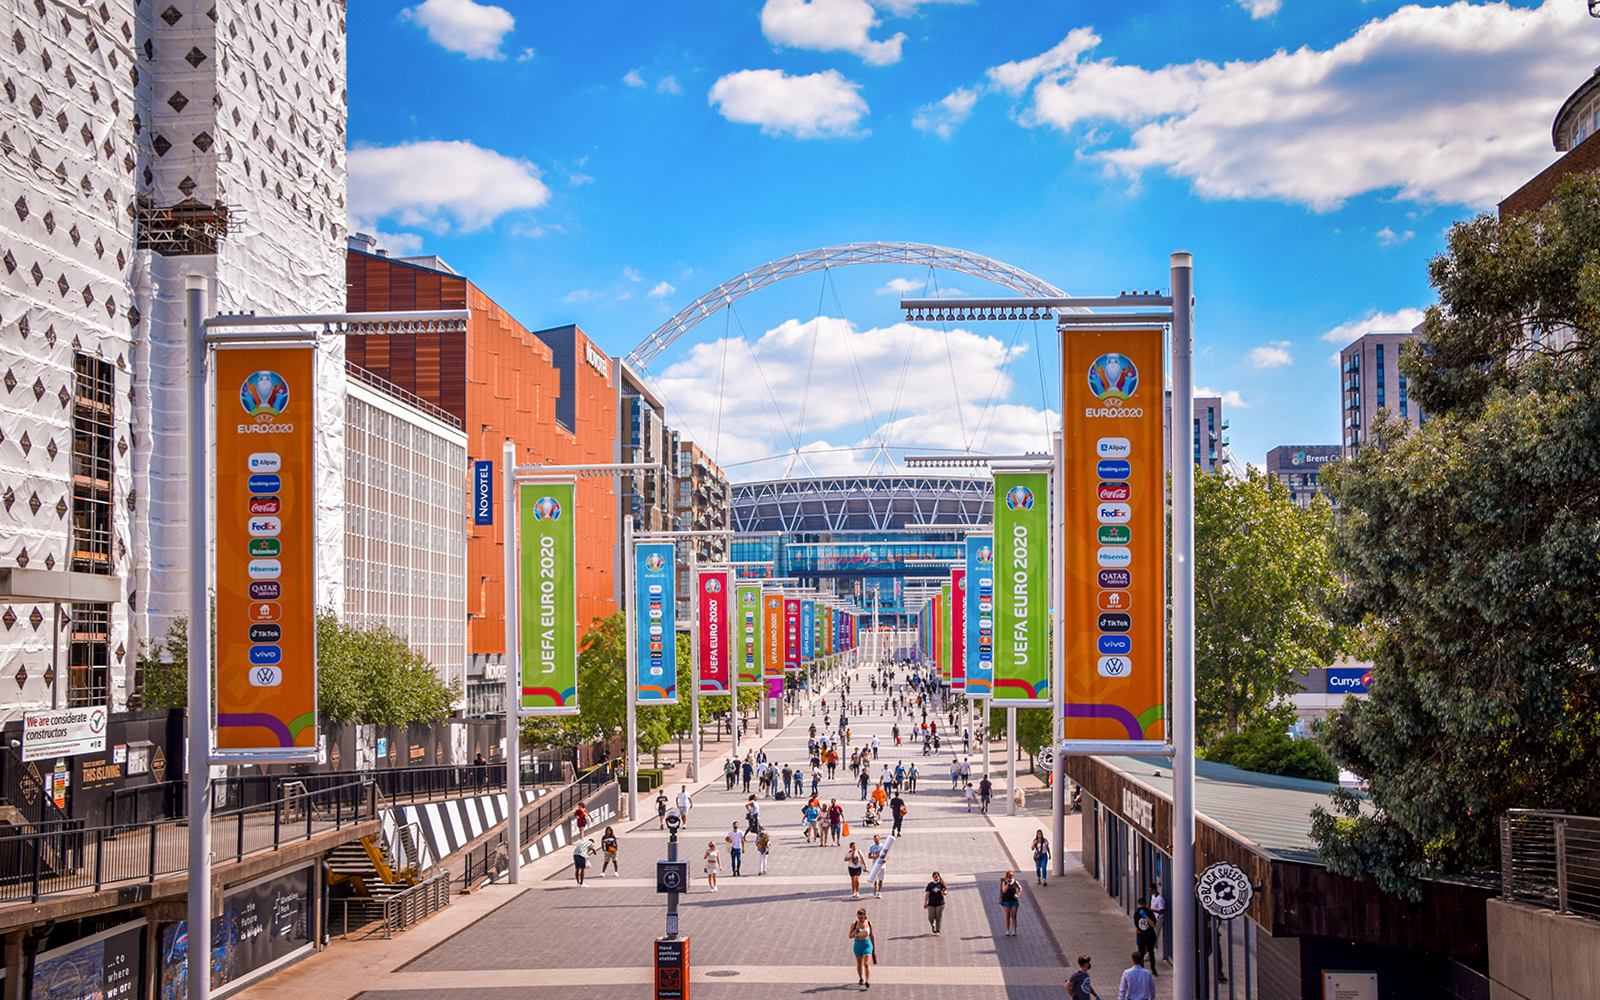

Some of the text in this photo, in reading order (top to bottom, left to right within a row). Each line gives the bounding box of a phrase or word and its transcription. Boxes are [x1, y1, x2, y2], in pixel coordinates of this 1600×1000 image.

[1103, 398, 1124, 407] UEFA
[254, 414, 275, 423] UEFA
[1085, 408, 1143, 418] EURO2020
[237, 423, 294, 434] EURO2020
[1306, 455, 1329, 463] Brent
[479, 464, 489, 517] NOVOTEL
[1101, 509, 1126, 517] FedEx
[252, 522, 277, 531] FedEx
[1101, 572, 1127, 581] QATAR
[252, 585, 278, 594] QATAR
[1013, 525, 1028, 665] UEFA EURO 2020
[540, 536, 555, 673] UEFA EURO 2020
[709, 599, 718, 673] UEFA EURO 2020
[1103, 640, 1125, 648] vivo
[485, 663, 507, 679] NOVOTE
[1330, 676, 1361, 687] Currys
[26, 716, 37, 727] We
[39, 717, 50, 727] are
[50, 712, 87, 726] considerate
[26, 728, 68, 741] constructors
[83, 767, 96, 782] THIS
[96, 766, 102, 780] IS
[1201, 868, 1243, 894] BLACK SHEEP
[1222, 900, 1244, 915] COFFEE
[241, 915, 258, 927] future
[241, 924, 263, 940] is bright
[107, 967, 130, 983] where
[107, 981, 132, 999] we are
